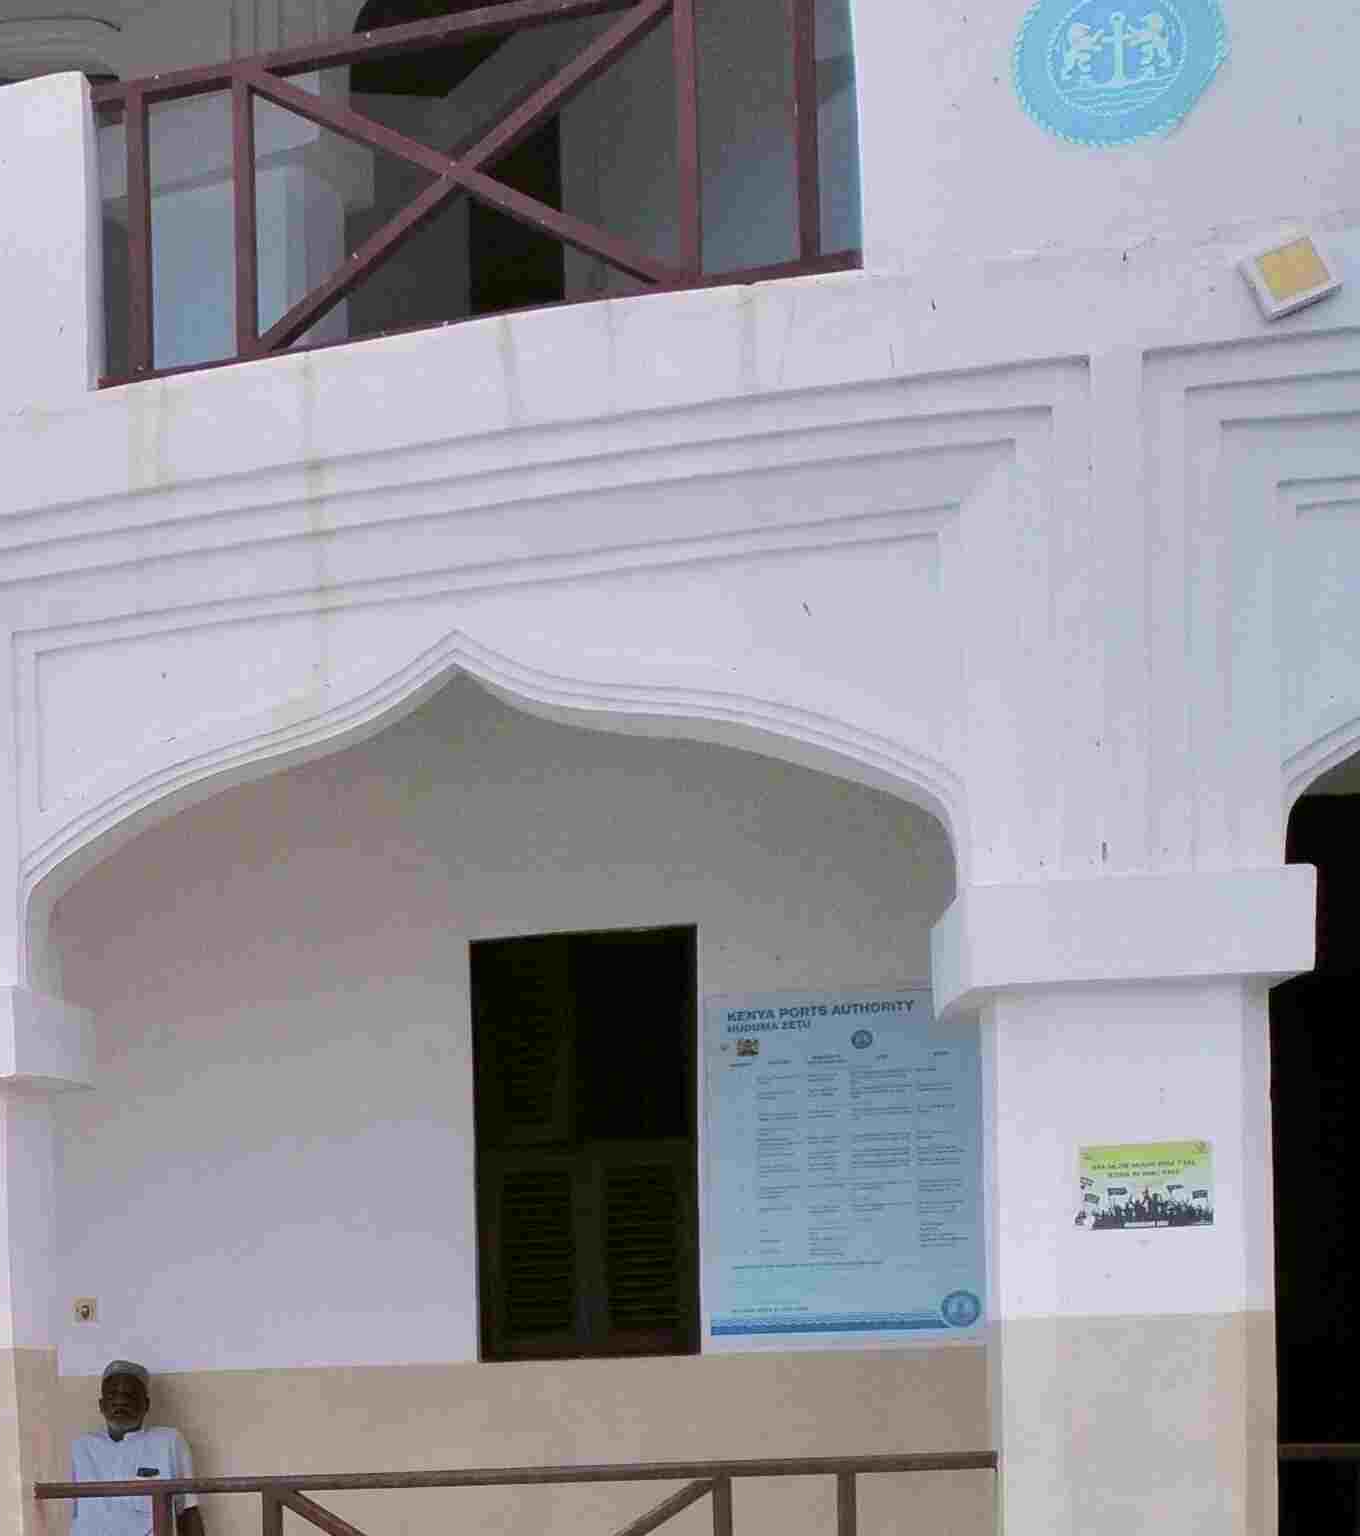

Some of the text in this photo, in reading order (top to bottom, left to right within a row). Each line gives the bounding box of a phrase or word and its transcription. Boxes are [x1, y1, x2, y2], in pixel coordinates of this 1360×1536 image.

[727, 999, 915, 1022] KENYA PORTS AUTHORITY
